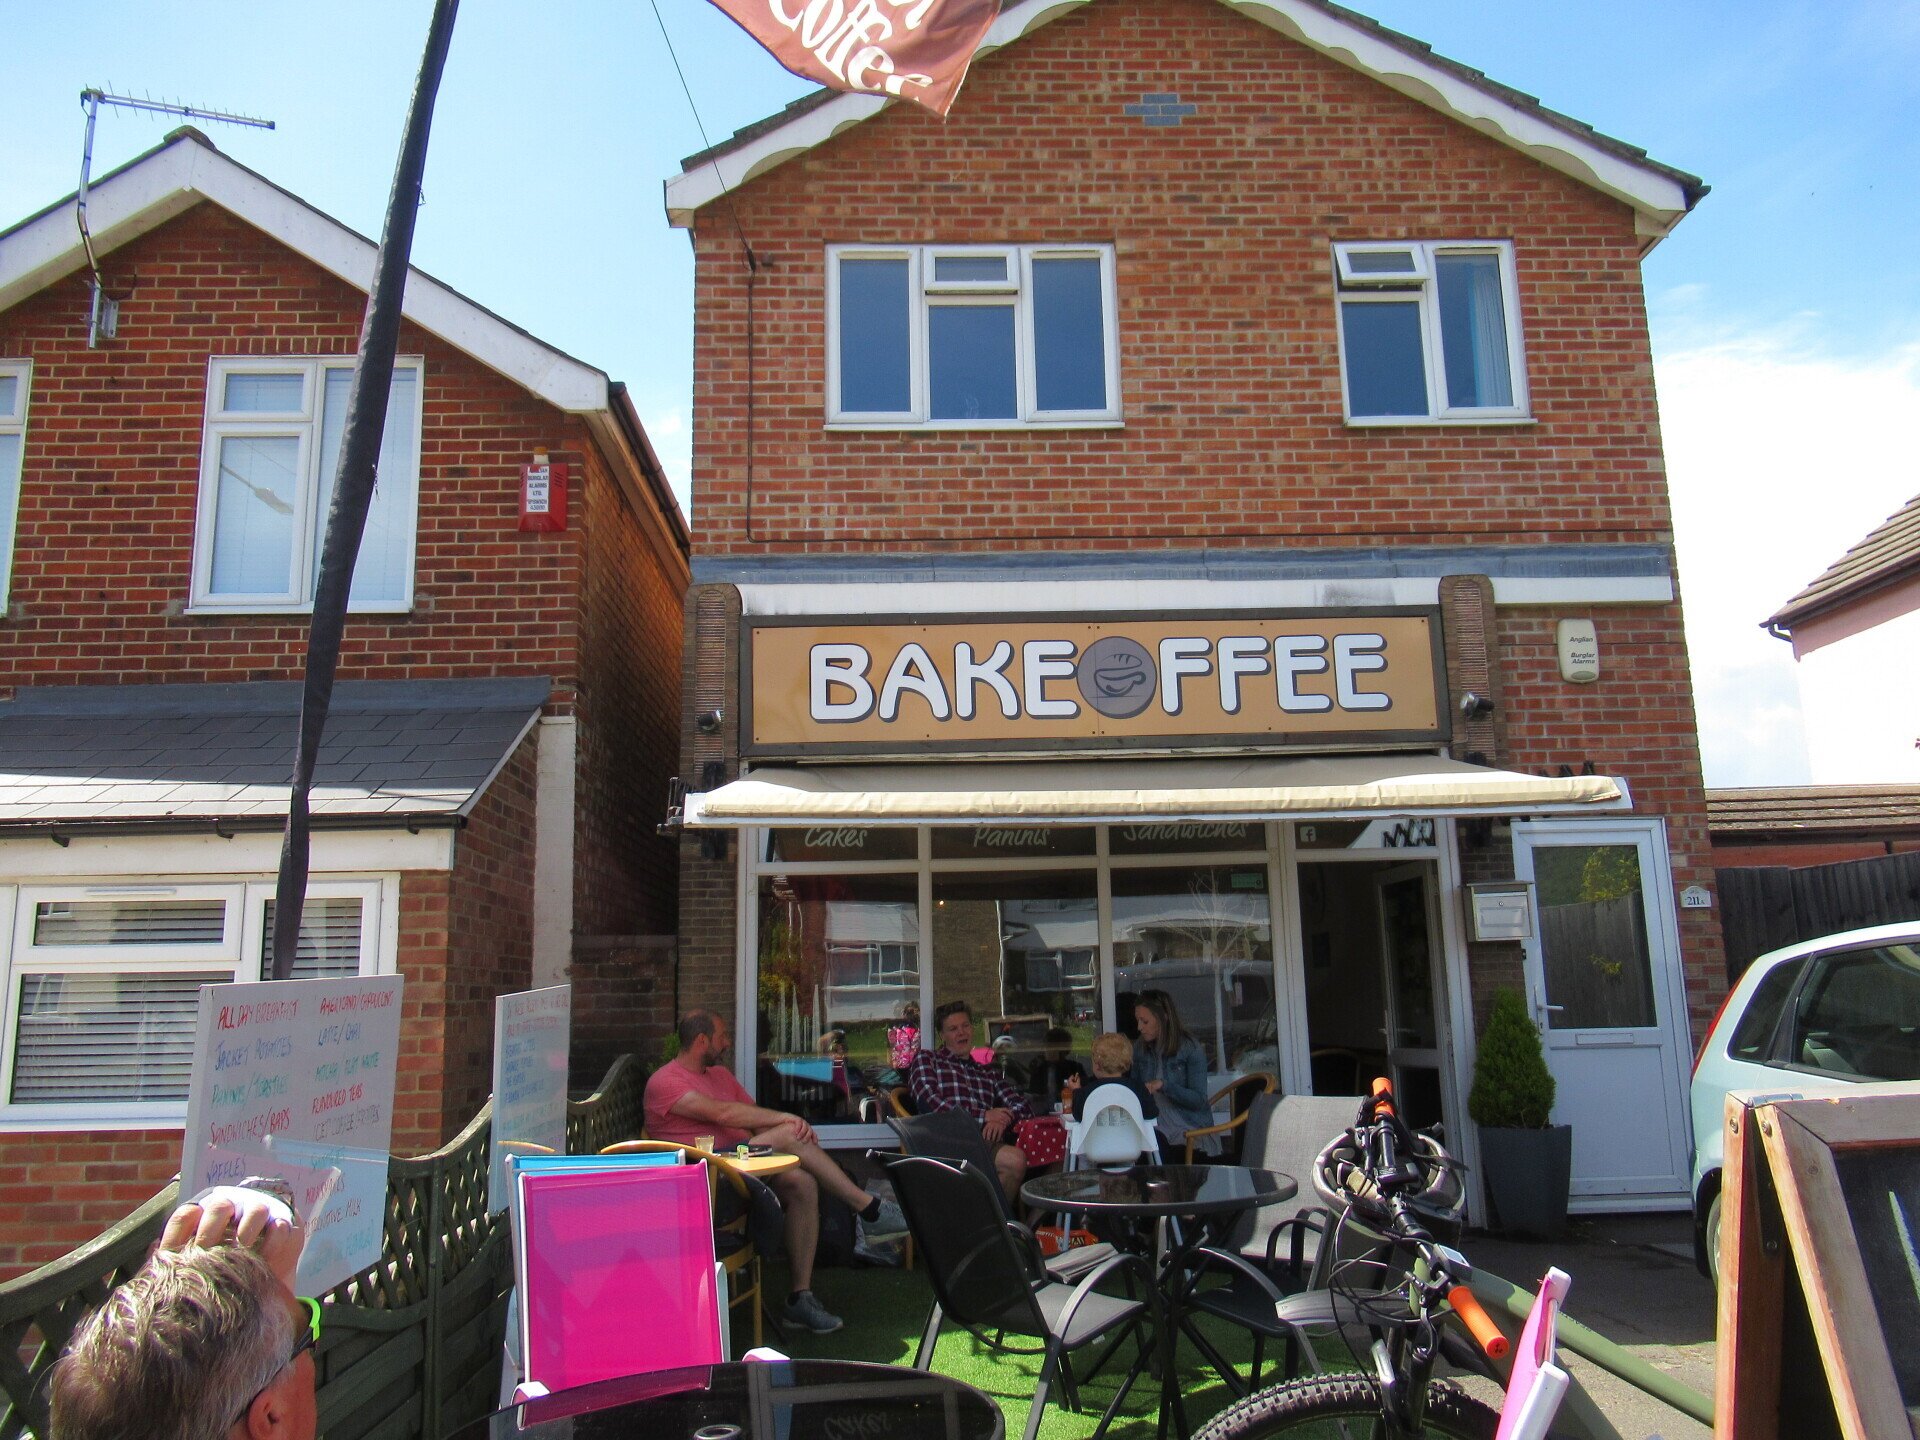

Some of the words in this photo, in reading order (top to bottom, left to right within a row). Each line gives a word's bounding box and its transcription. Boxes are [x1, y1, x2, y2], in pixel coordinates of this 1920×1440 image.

[804, 827, 867, 847] Cakes
[217, 1005, 235, 1030] ALL
[237, 1004, 254, 1028] DAY
[214, 1040, 250, 1071] JACKET
[207, 1156, 246, 1185] WAFFLES
